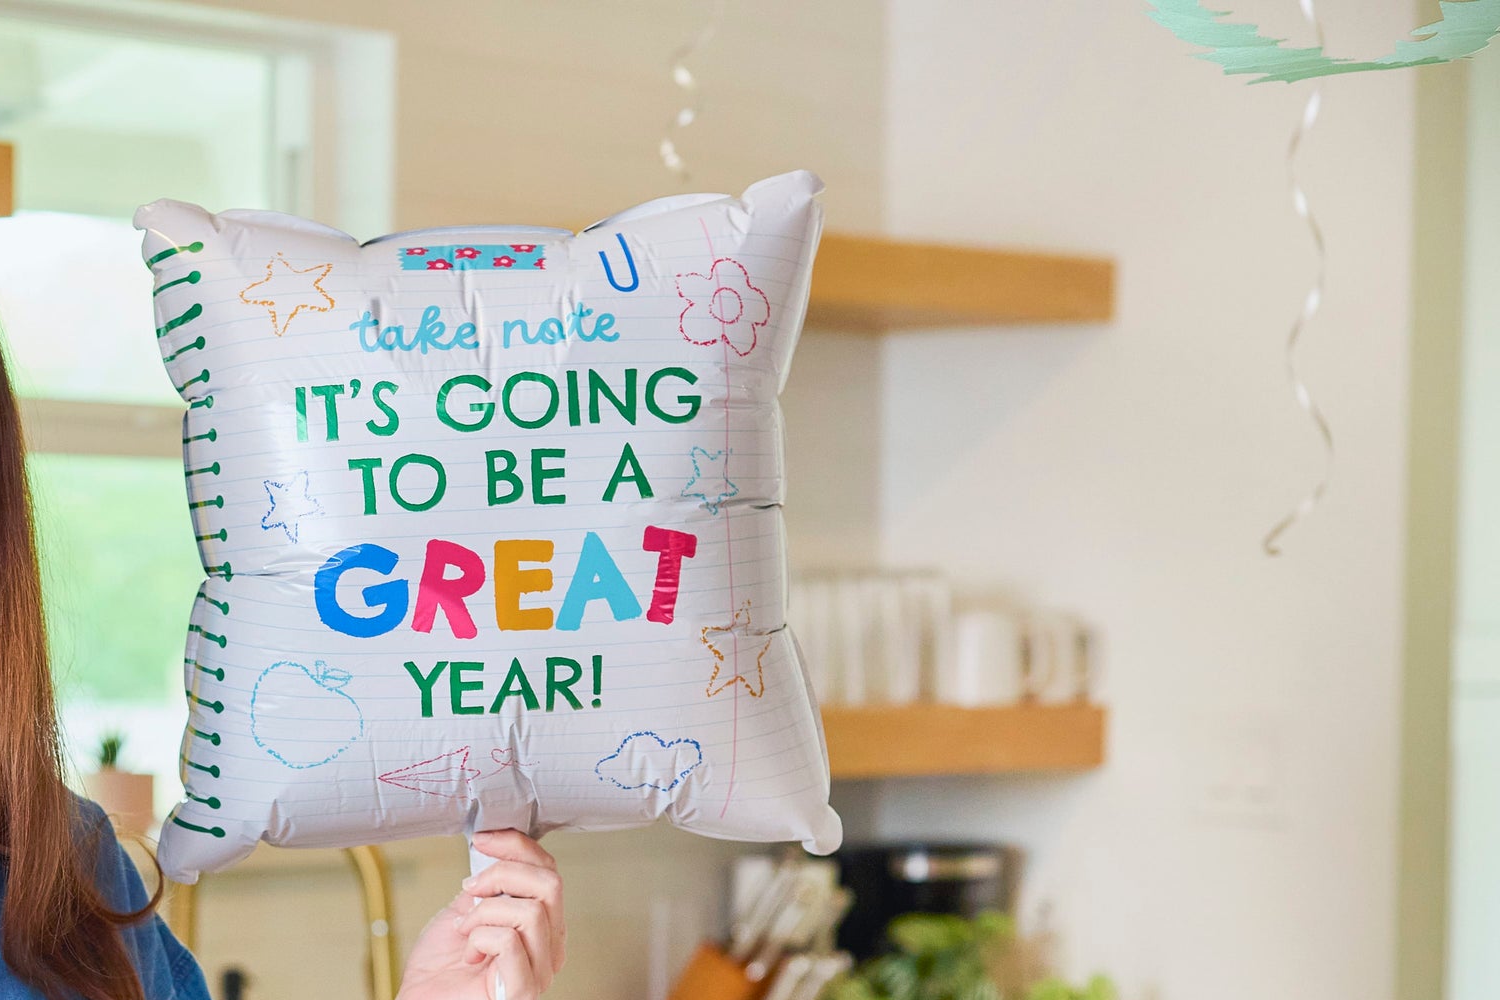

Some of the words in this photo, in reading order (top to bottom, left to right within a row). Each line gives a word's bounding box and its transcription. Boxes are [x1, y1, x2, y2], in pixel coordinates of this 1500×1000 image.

[350, 305, 480, 355] take
[503, 302, 621, 349] note
[295, 378, 400, 442] IT'S
[435, 366, 702, 433] GOING
[347, 453, 447, 516] TO
[484, 448, 567, 507] BE
[601, 442, 654, 503] A
[313, 525, 698, 640] GREAT
[403, 654, 603, 718] YEAR!
